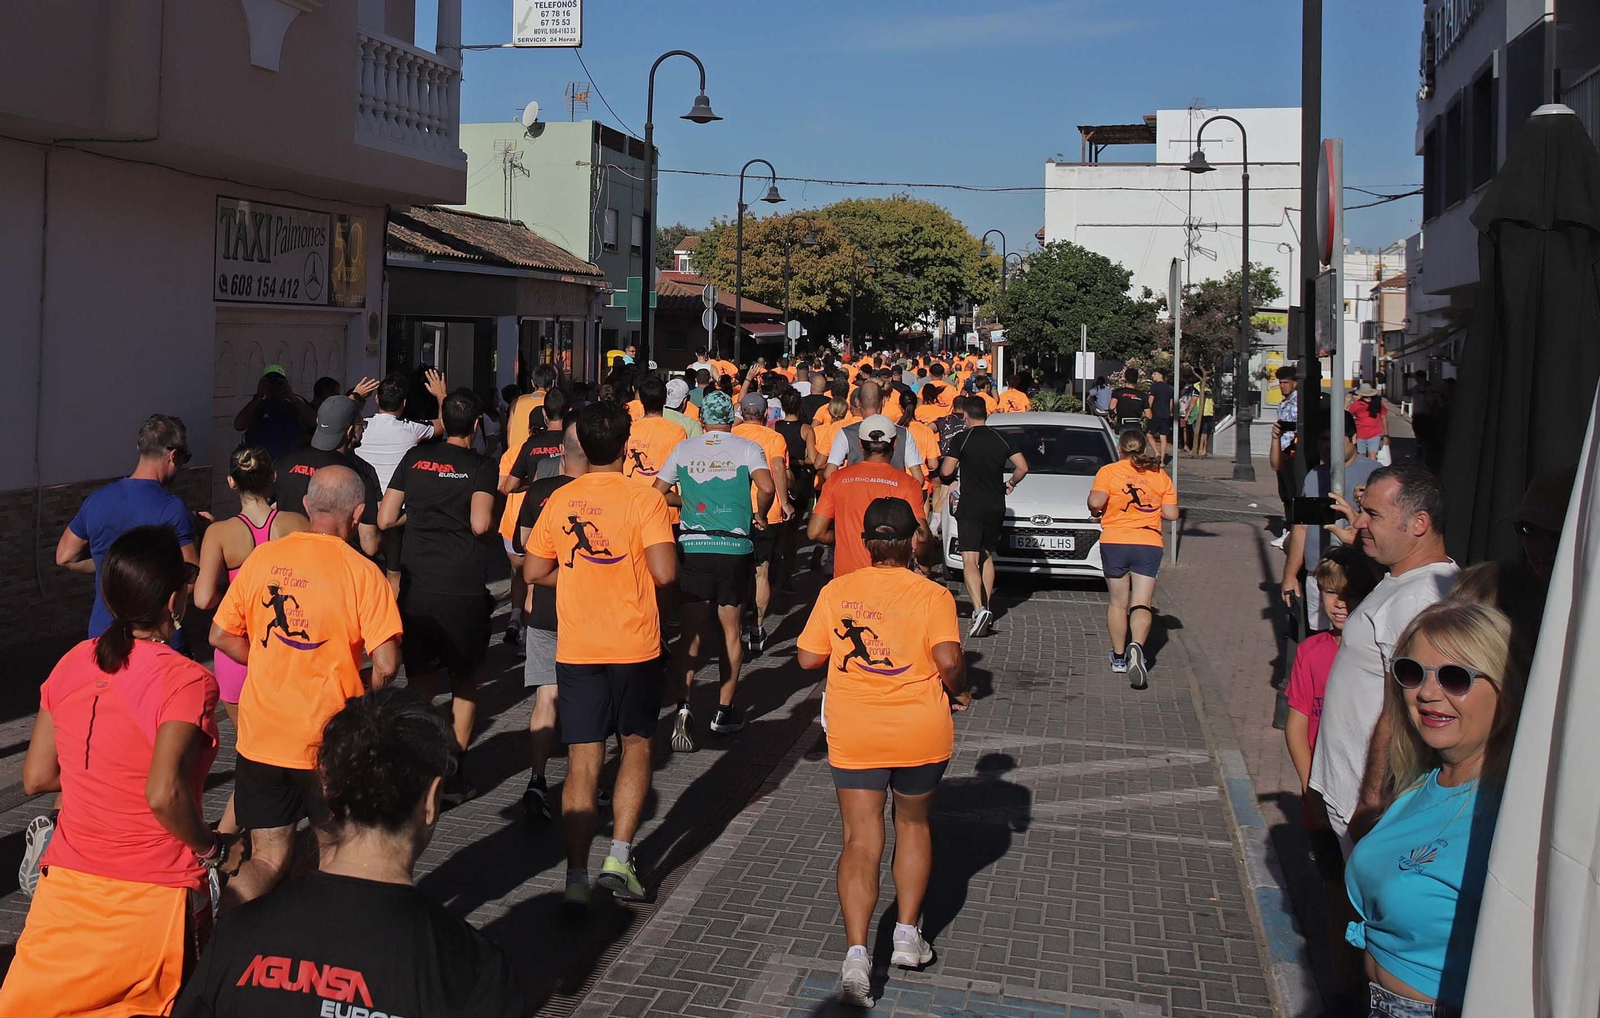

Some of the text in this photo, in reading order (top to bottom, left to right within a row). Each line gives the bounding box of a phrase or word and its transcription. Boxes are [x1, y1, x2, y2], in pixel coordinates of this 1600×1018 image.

[534, 0, 578, 9] TELEFONOS
[220, 206, 326, 264] TAXI Palmones
[230, 273, 300, 299] 608 154 412
[411, 460, 456, 473] AGUNSA
[1017, 537, 1072, 549] 6224 LHS
[235, 954, 374, 1008] AGUNSA
